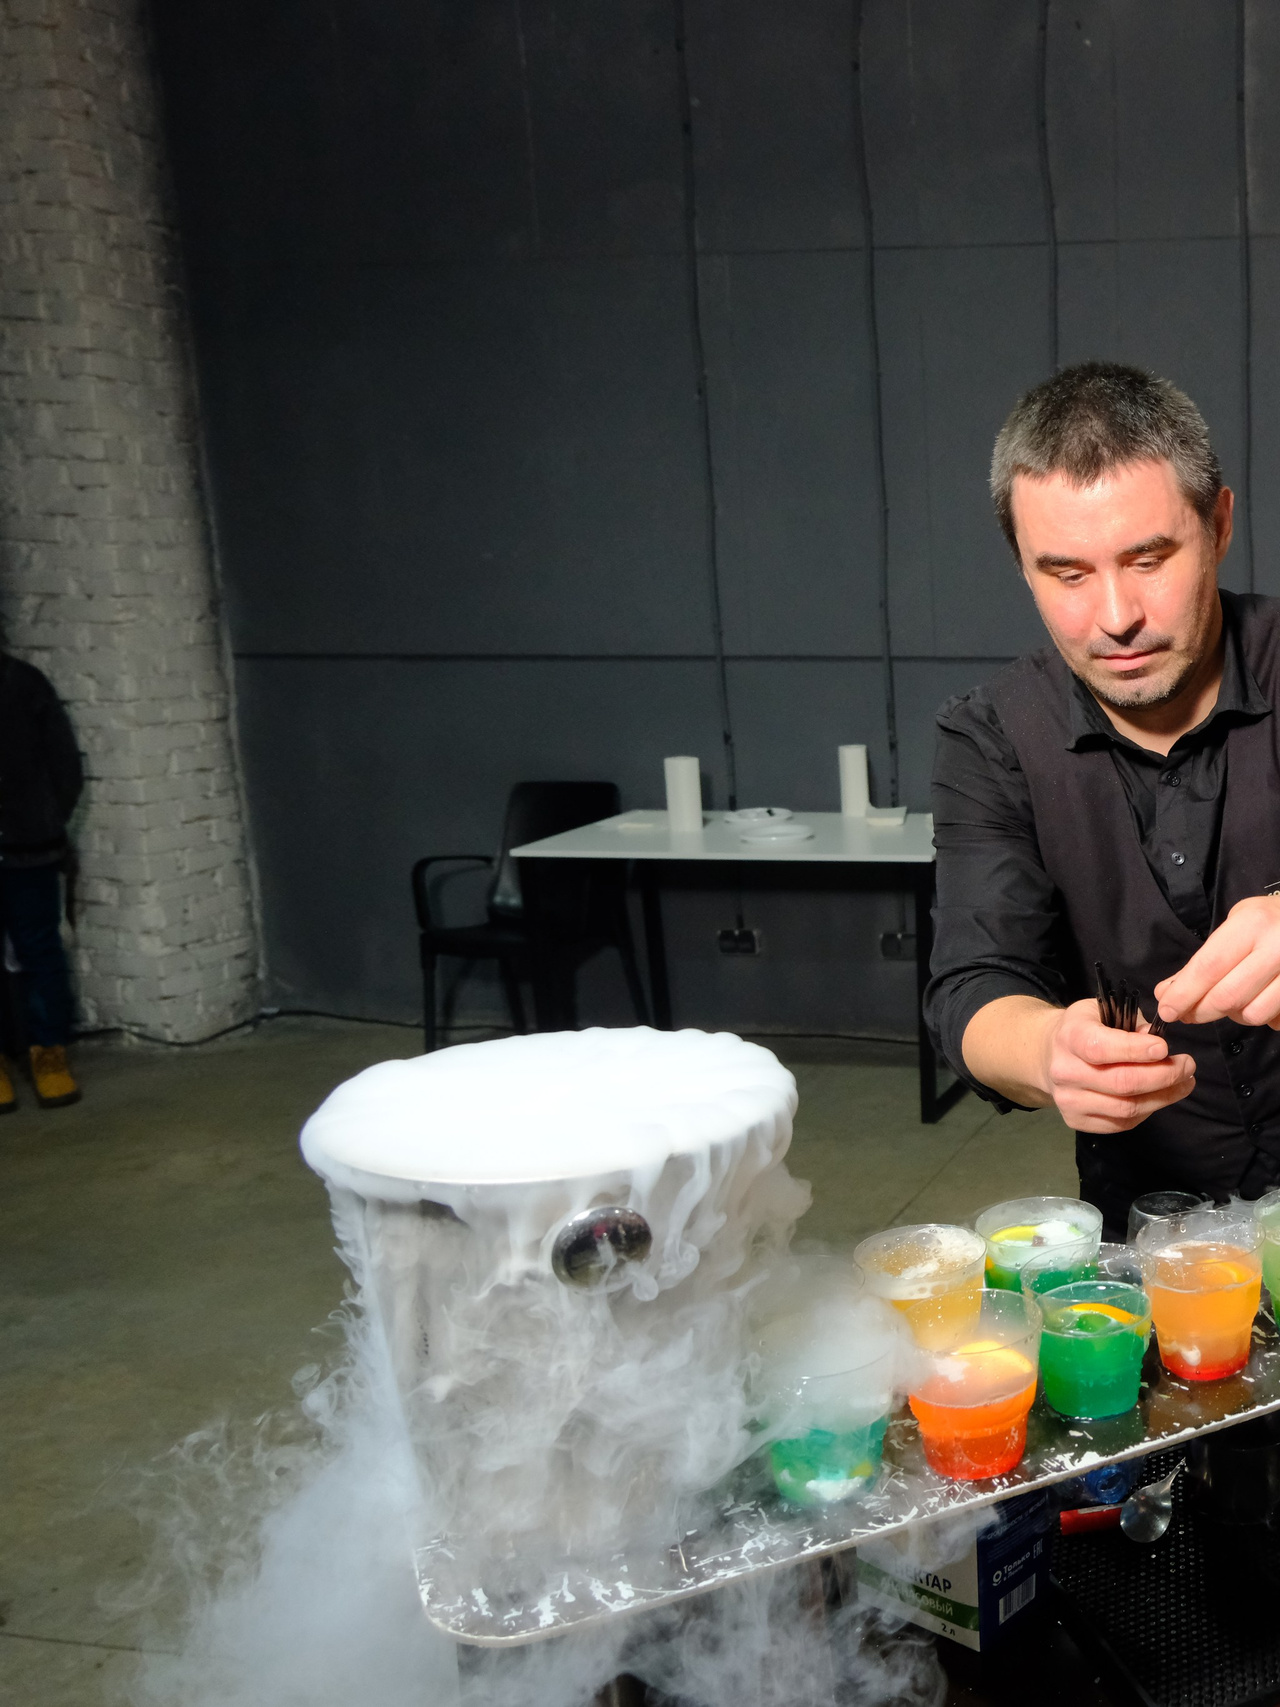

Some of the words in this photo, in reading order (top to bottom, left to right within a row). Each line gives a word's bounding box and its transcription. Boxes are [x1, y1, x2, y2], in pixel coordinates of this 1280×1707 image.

[1003, 1551, 1031, 1574] Только
[941, 1623, 948, 1633] 2
[949, 1629, 956, 1637] л
